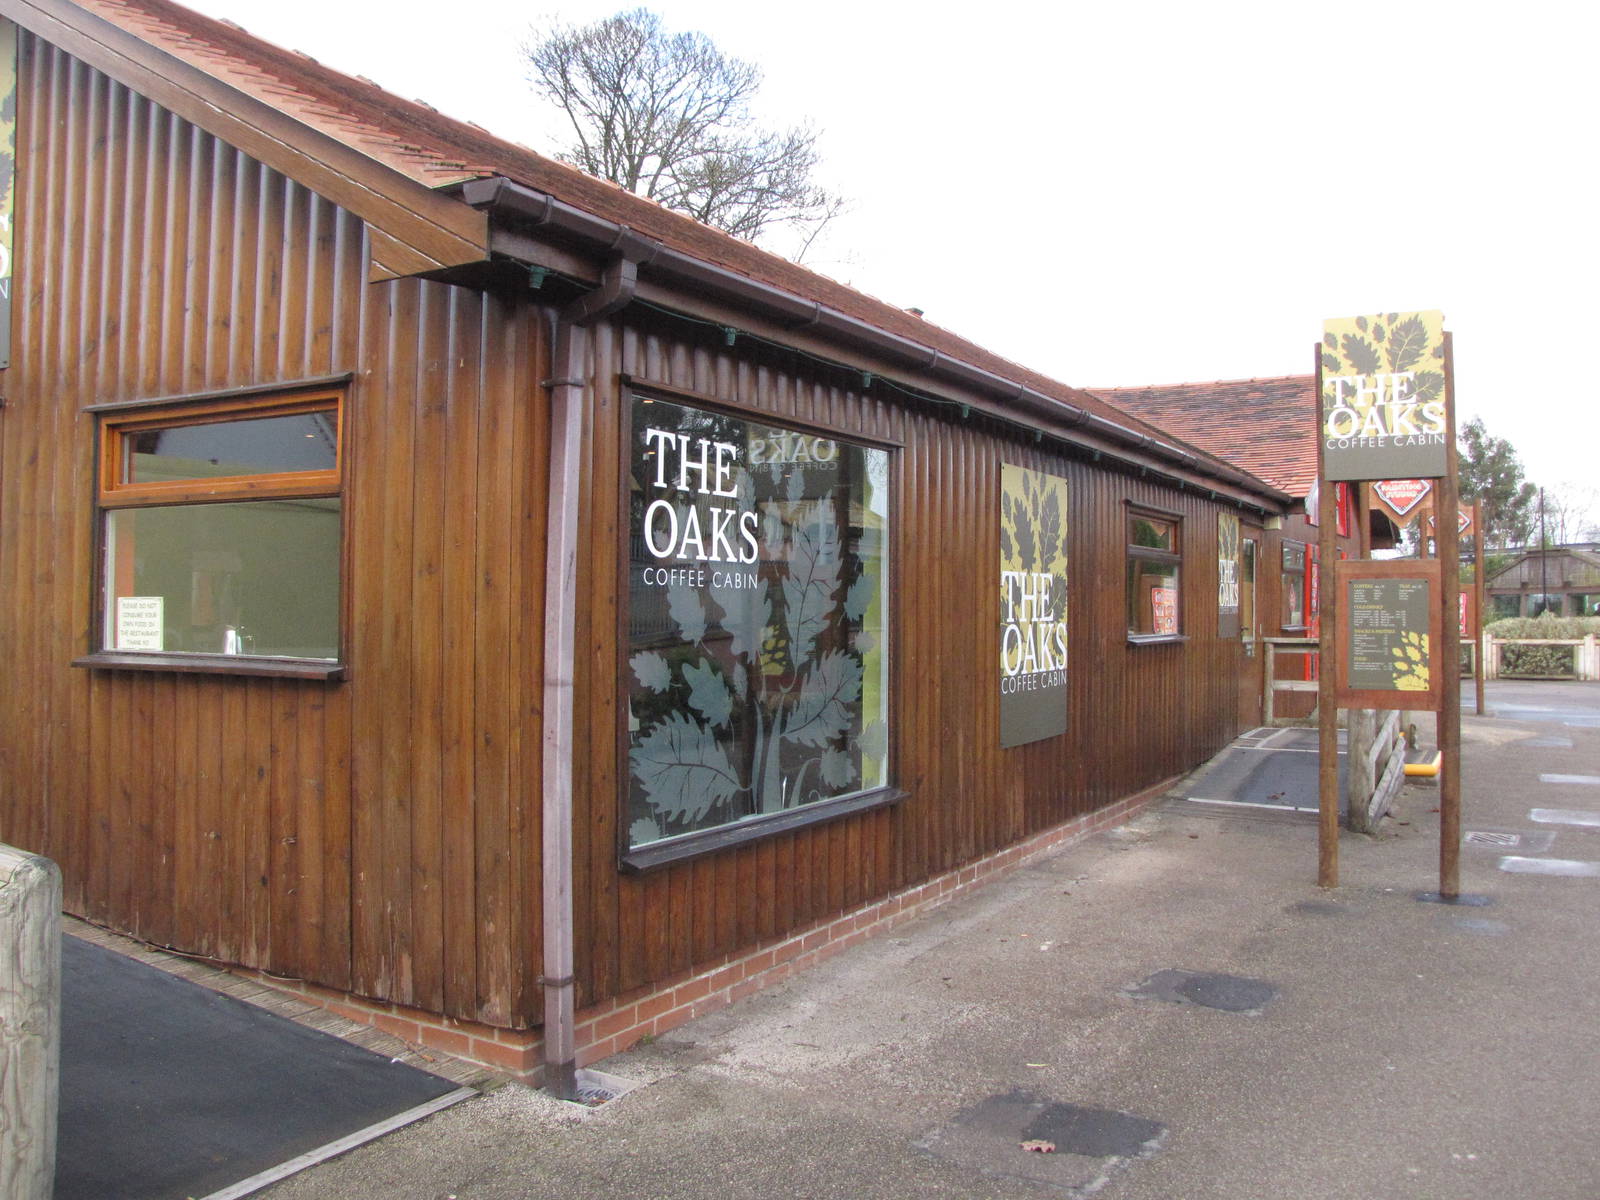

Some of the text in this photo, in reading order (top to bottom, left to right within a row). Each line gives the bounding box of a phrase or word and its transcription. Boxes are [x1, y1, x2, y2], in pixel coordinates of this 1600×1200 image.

[1324, 372, 1417, 408] THE
[1327, 401, 1446, 439] OAKS
[1326, 434, 1445, 450] COFFEE CABIN
[646, 428, 738, 498] THE
[644, 500, 759, 564] OAKS
[643, 567, 759, 590] COFFEE CABIN
[1218, 559, 1235, 584] THE
[1000, 570, 1054, 623] THE
[1219, 583, 1239, 607] OAKS
[1002, 622, 1068, 677] OAKS
[1001, 669, 1067, 695] COFFEE CABIN
